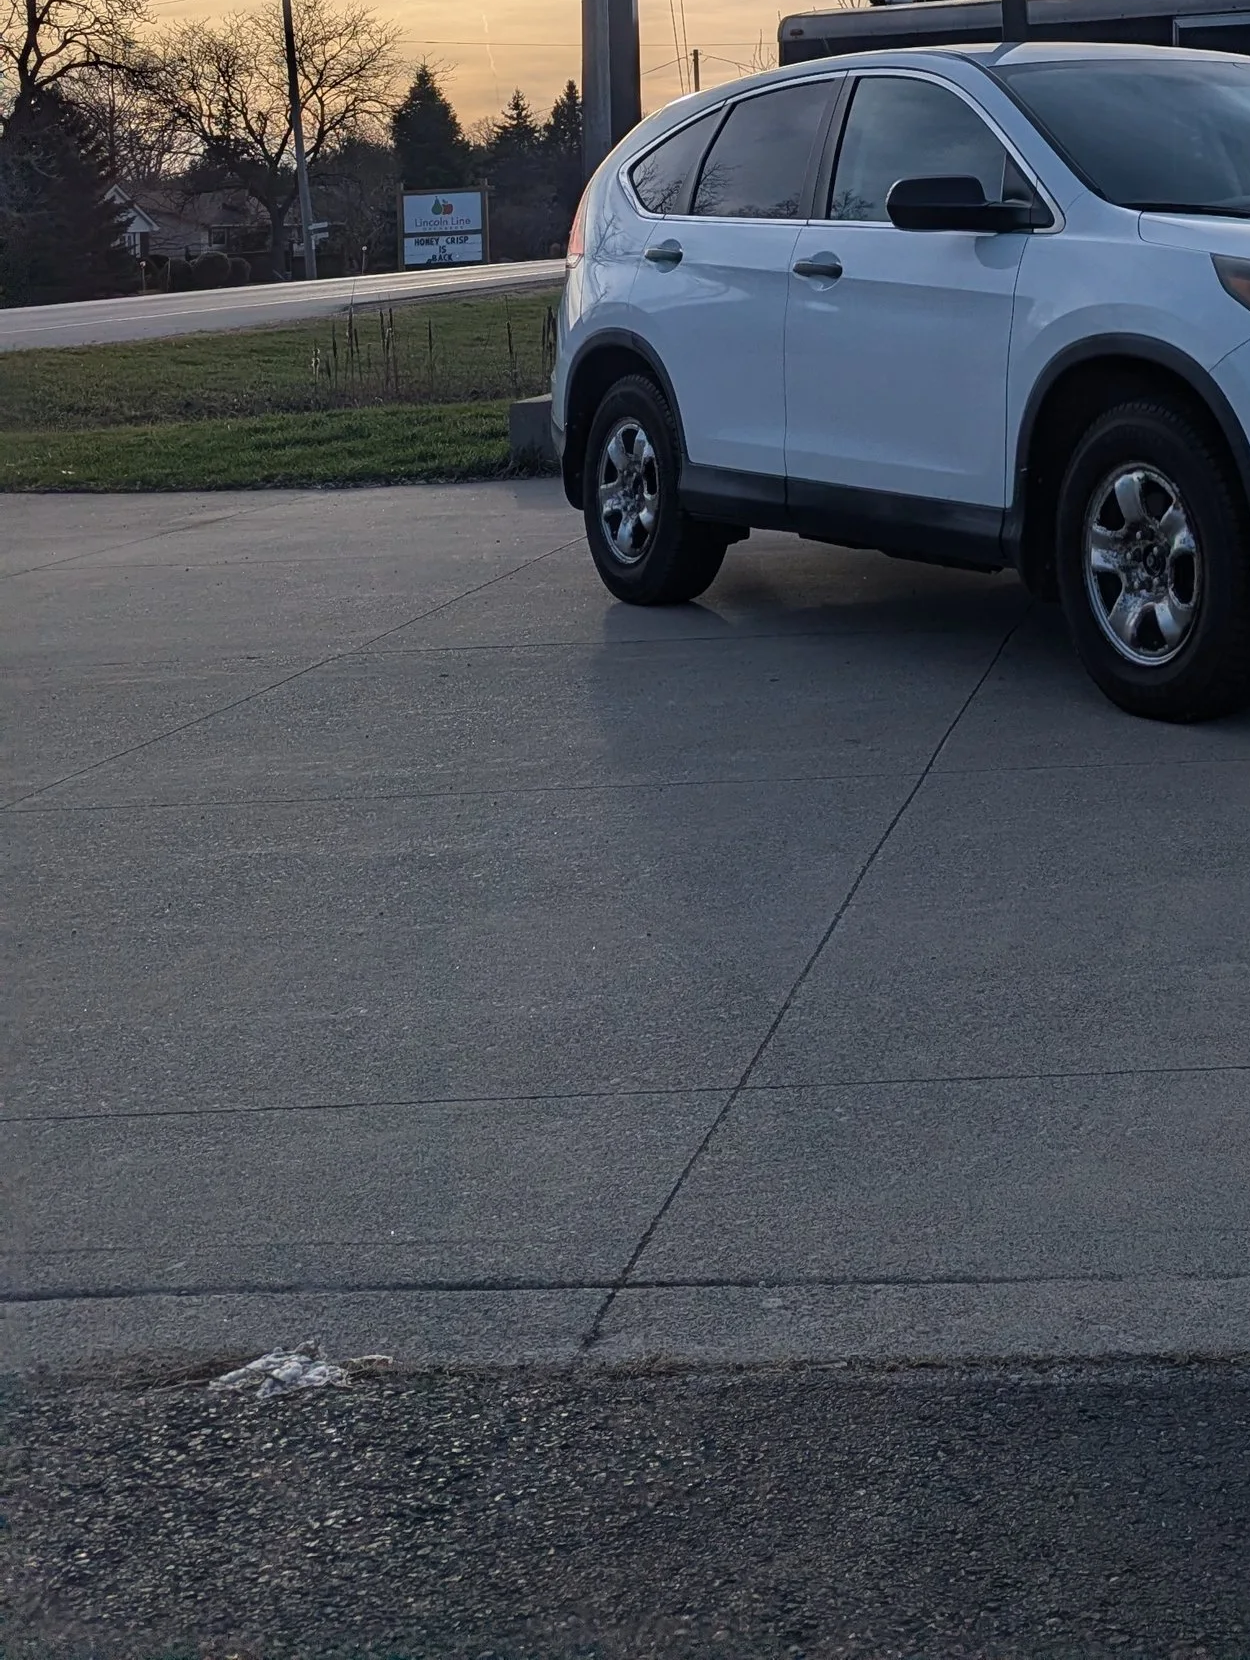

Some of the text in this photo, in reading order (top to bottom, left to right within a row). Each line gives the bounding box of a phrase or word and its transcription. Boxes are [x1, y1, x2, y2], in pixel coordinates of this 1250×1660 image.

[415, 216, 471, 227] Lincoln Line
[414, 236, 469, 246] HONEY CRISP
[439, 245, 447, 253] IS
[431, 253, 453, 262] BACK
